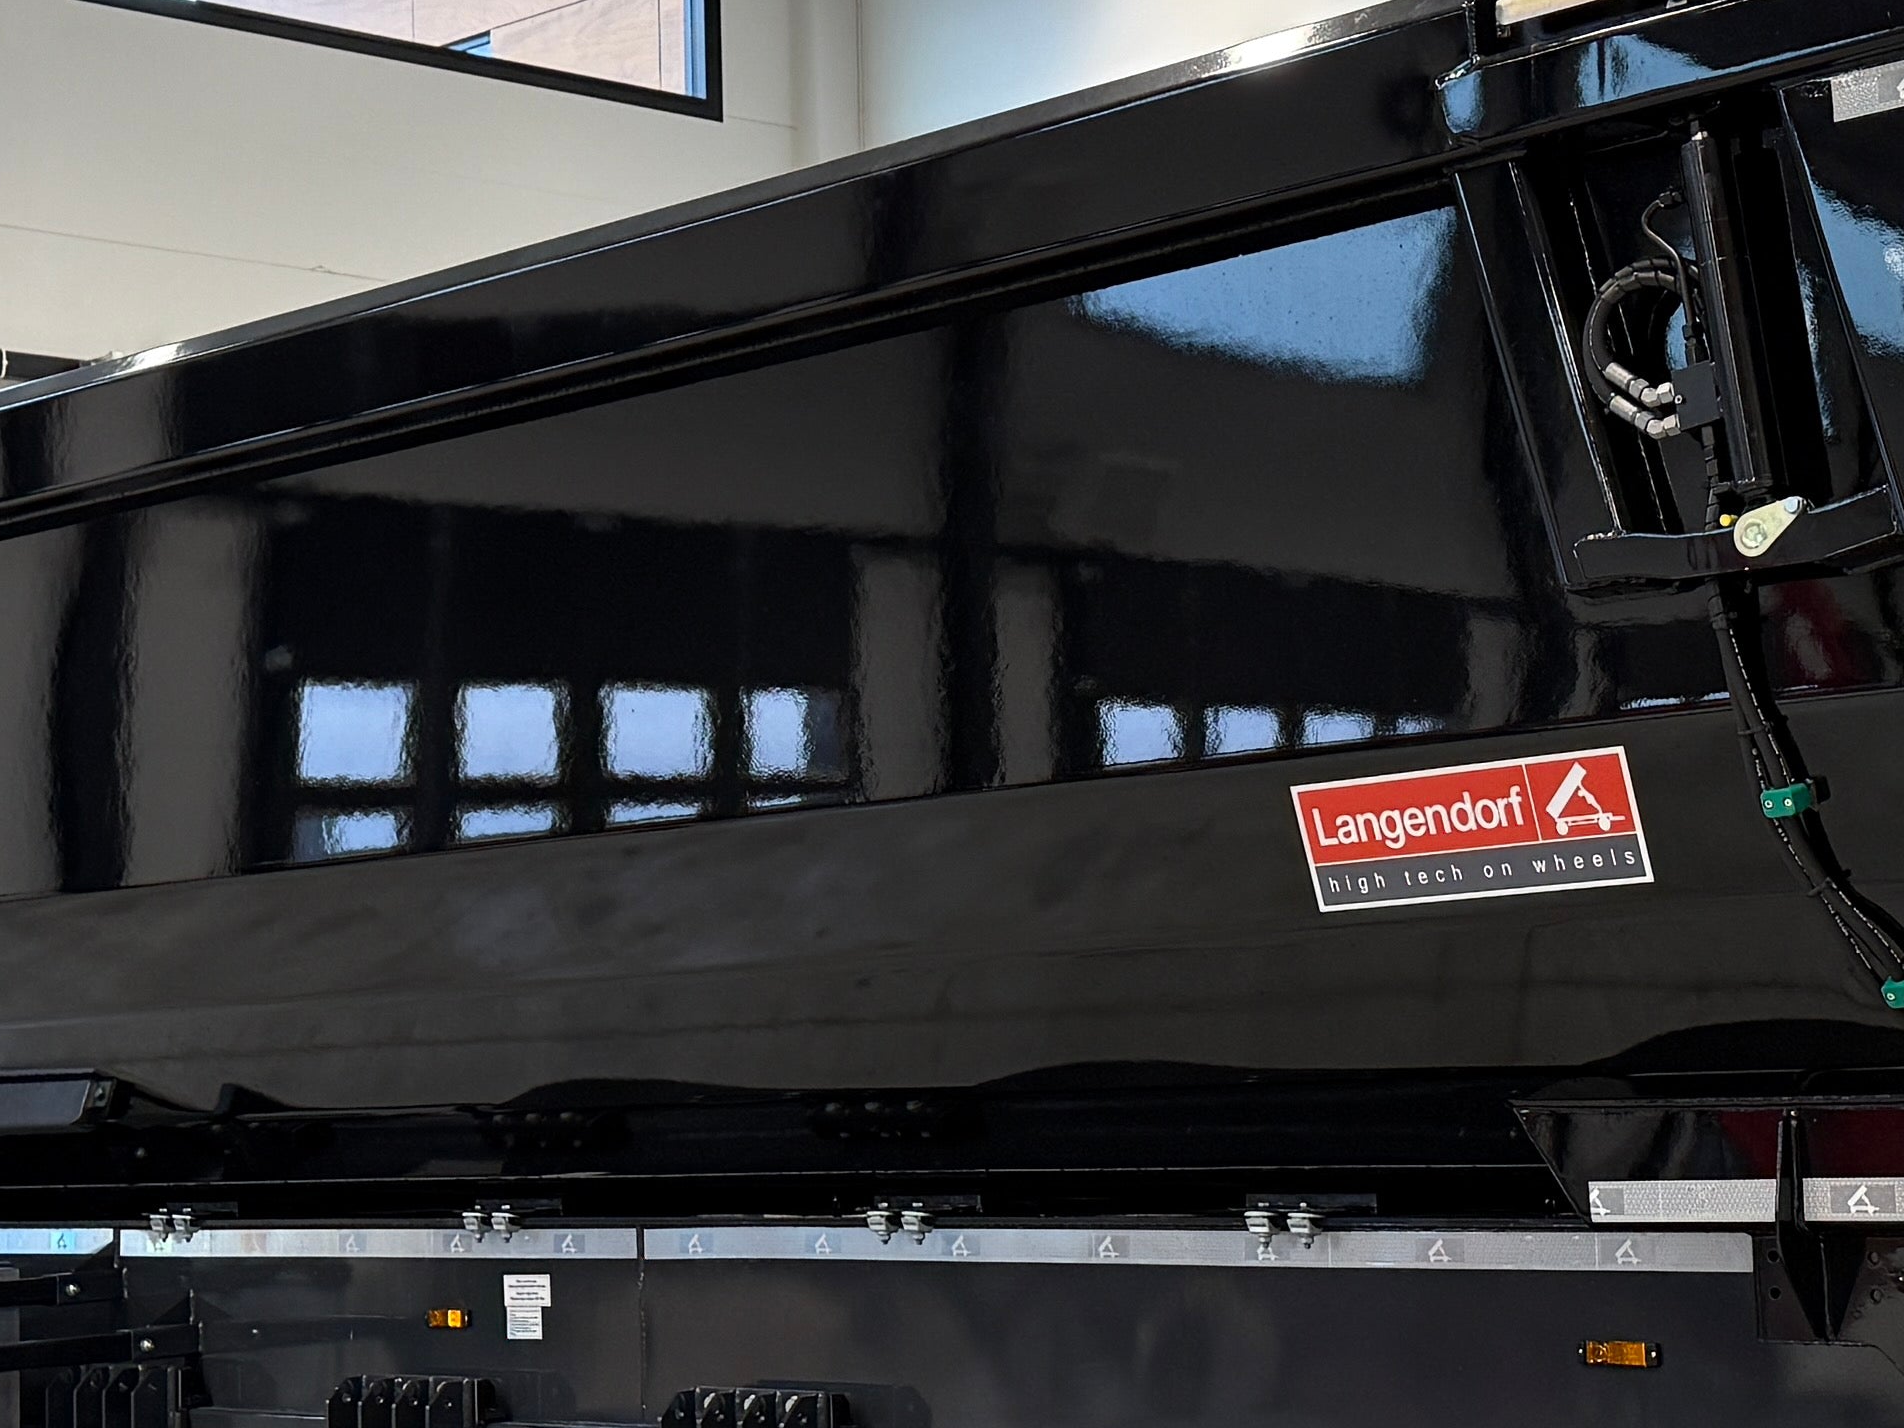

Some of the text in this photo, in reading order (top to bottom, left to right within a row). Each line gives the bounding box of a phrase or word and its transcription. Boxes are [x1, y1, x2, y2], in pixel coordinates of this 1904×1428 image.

[1311, 785, 1526, 850] Langendorf
[1328, 847, 1637, 895] high tech on wheels
